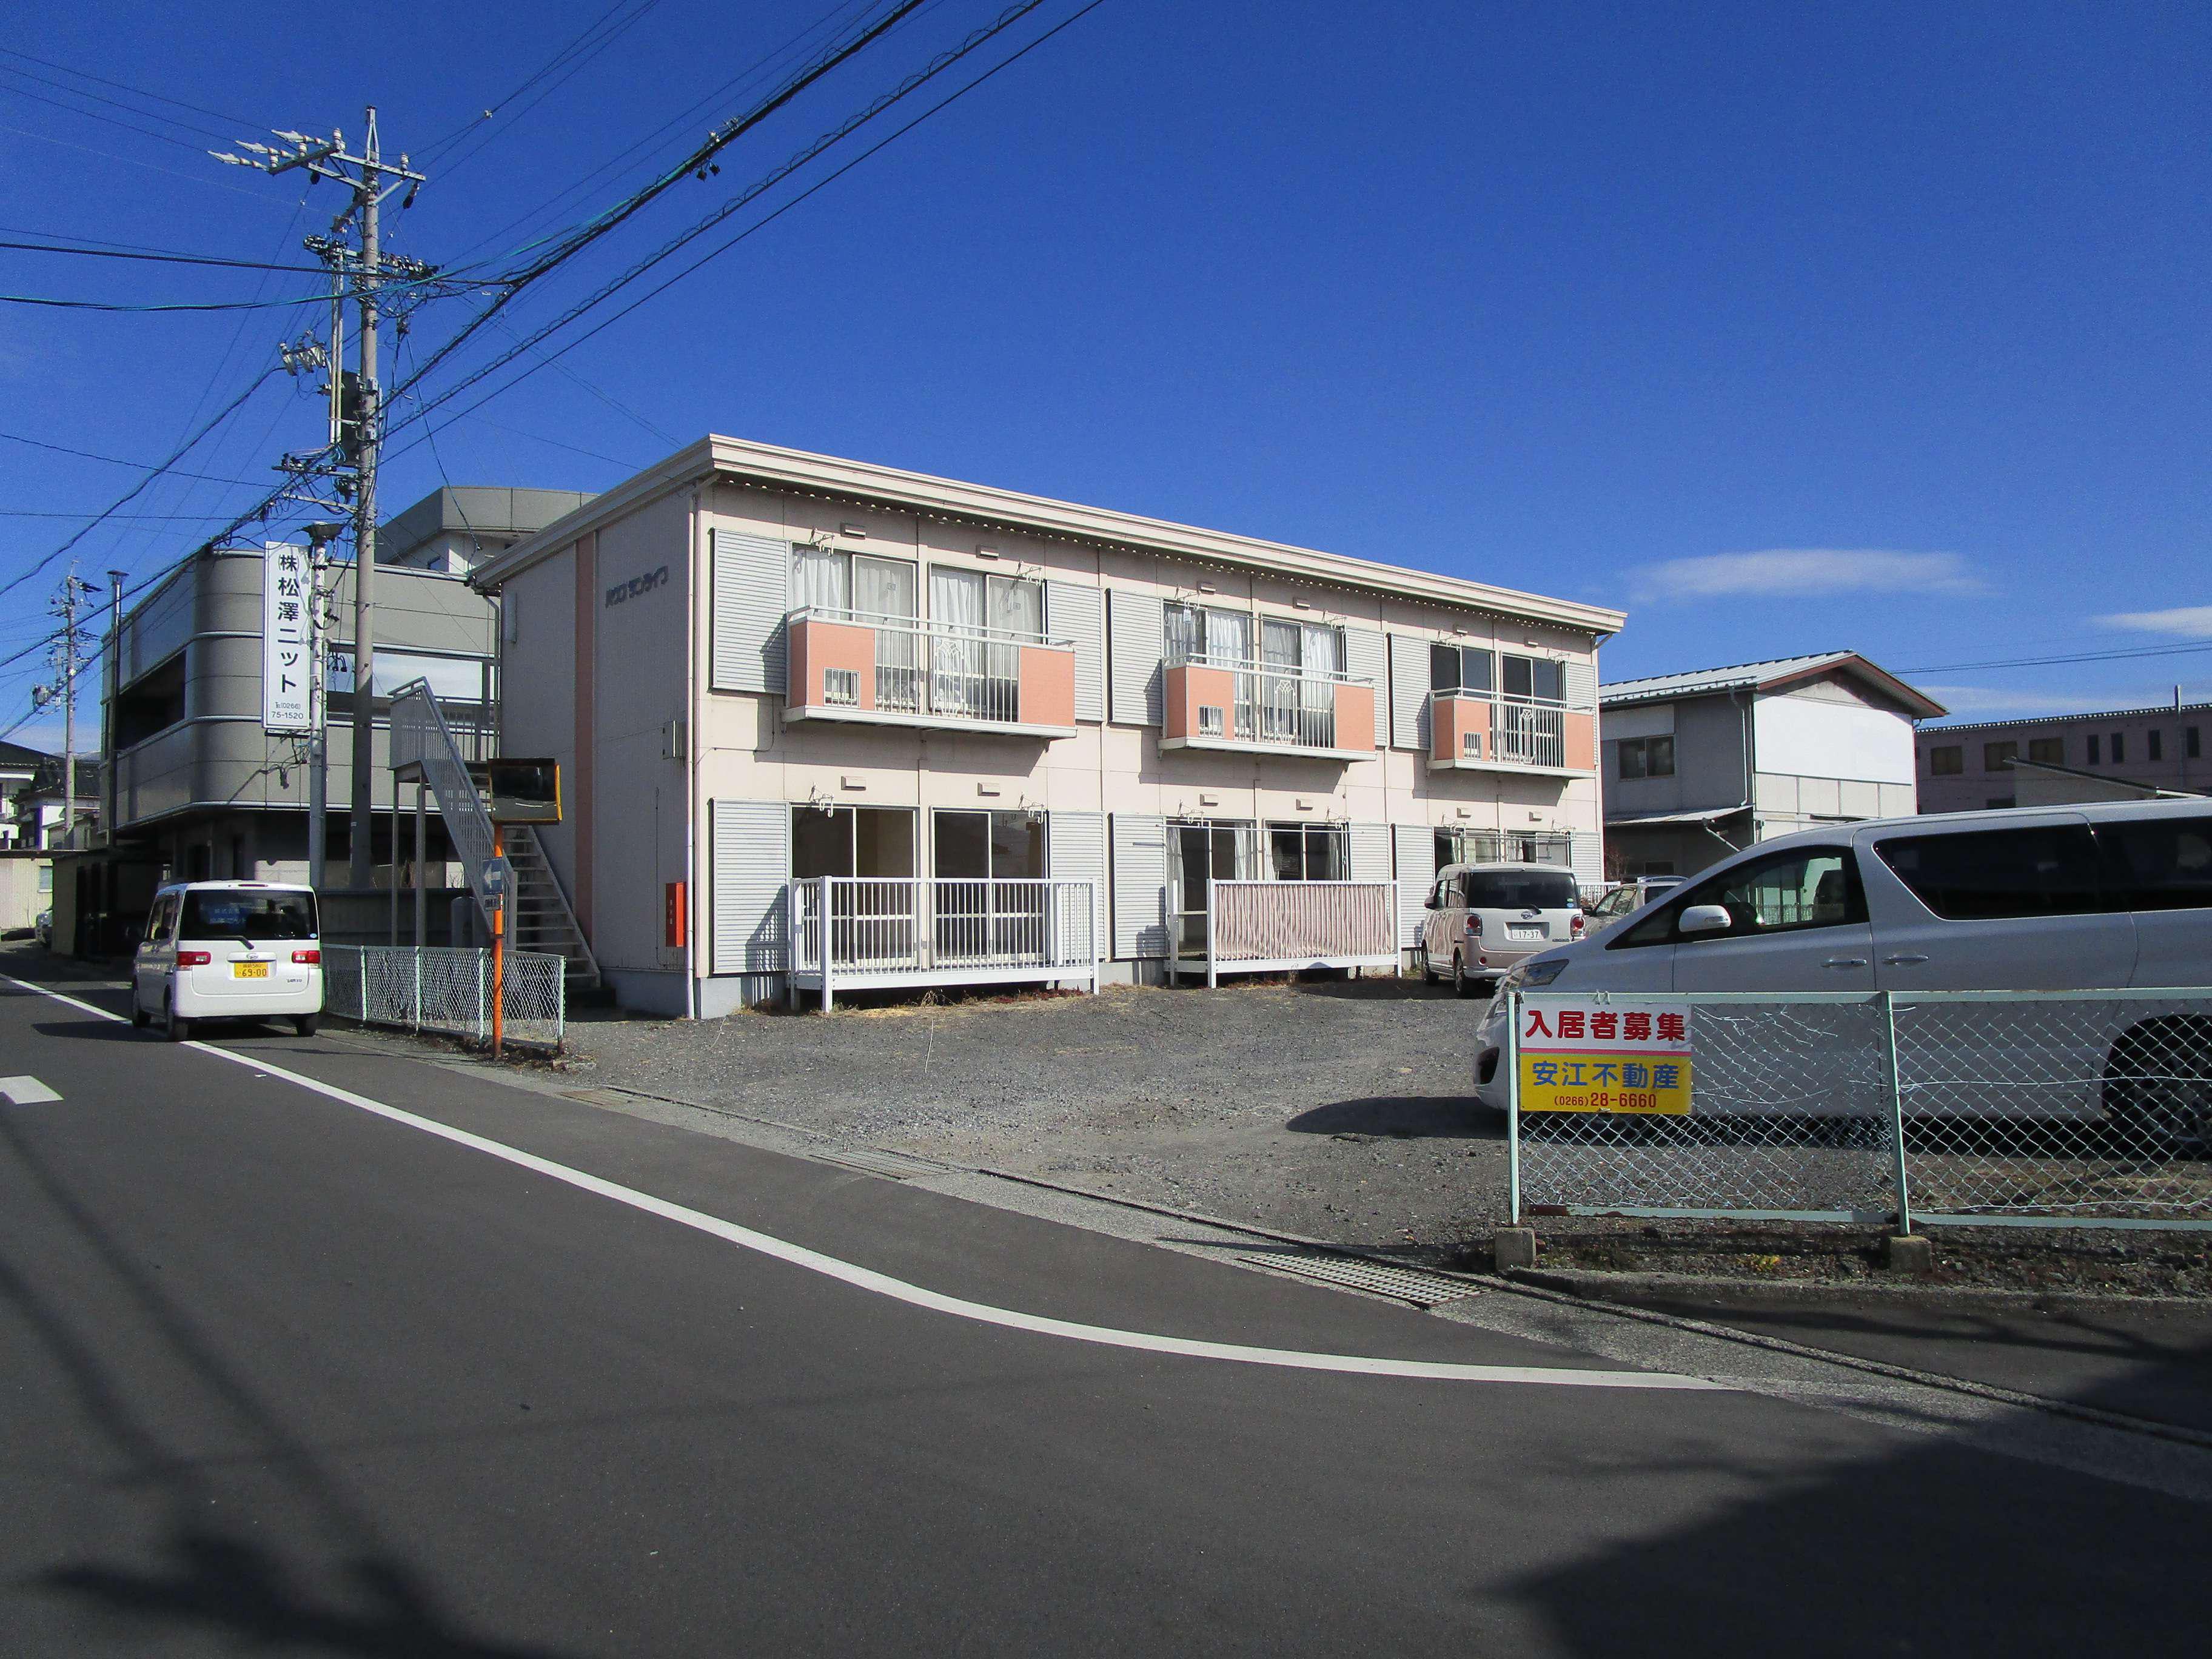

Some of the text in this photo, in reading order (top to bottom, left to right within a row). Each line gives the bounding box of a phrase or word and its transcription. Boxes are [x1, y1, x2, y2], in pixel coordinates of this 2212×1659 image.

[1525, 1010, 1686, 1041] 入居者募集
[1532, 1061, 1679, 1089] 安江不動産
